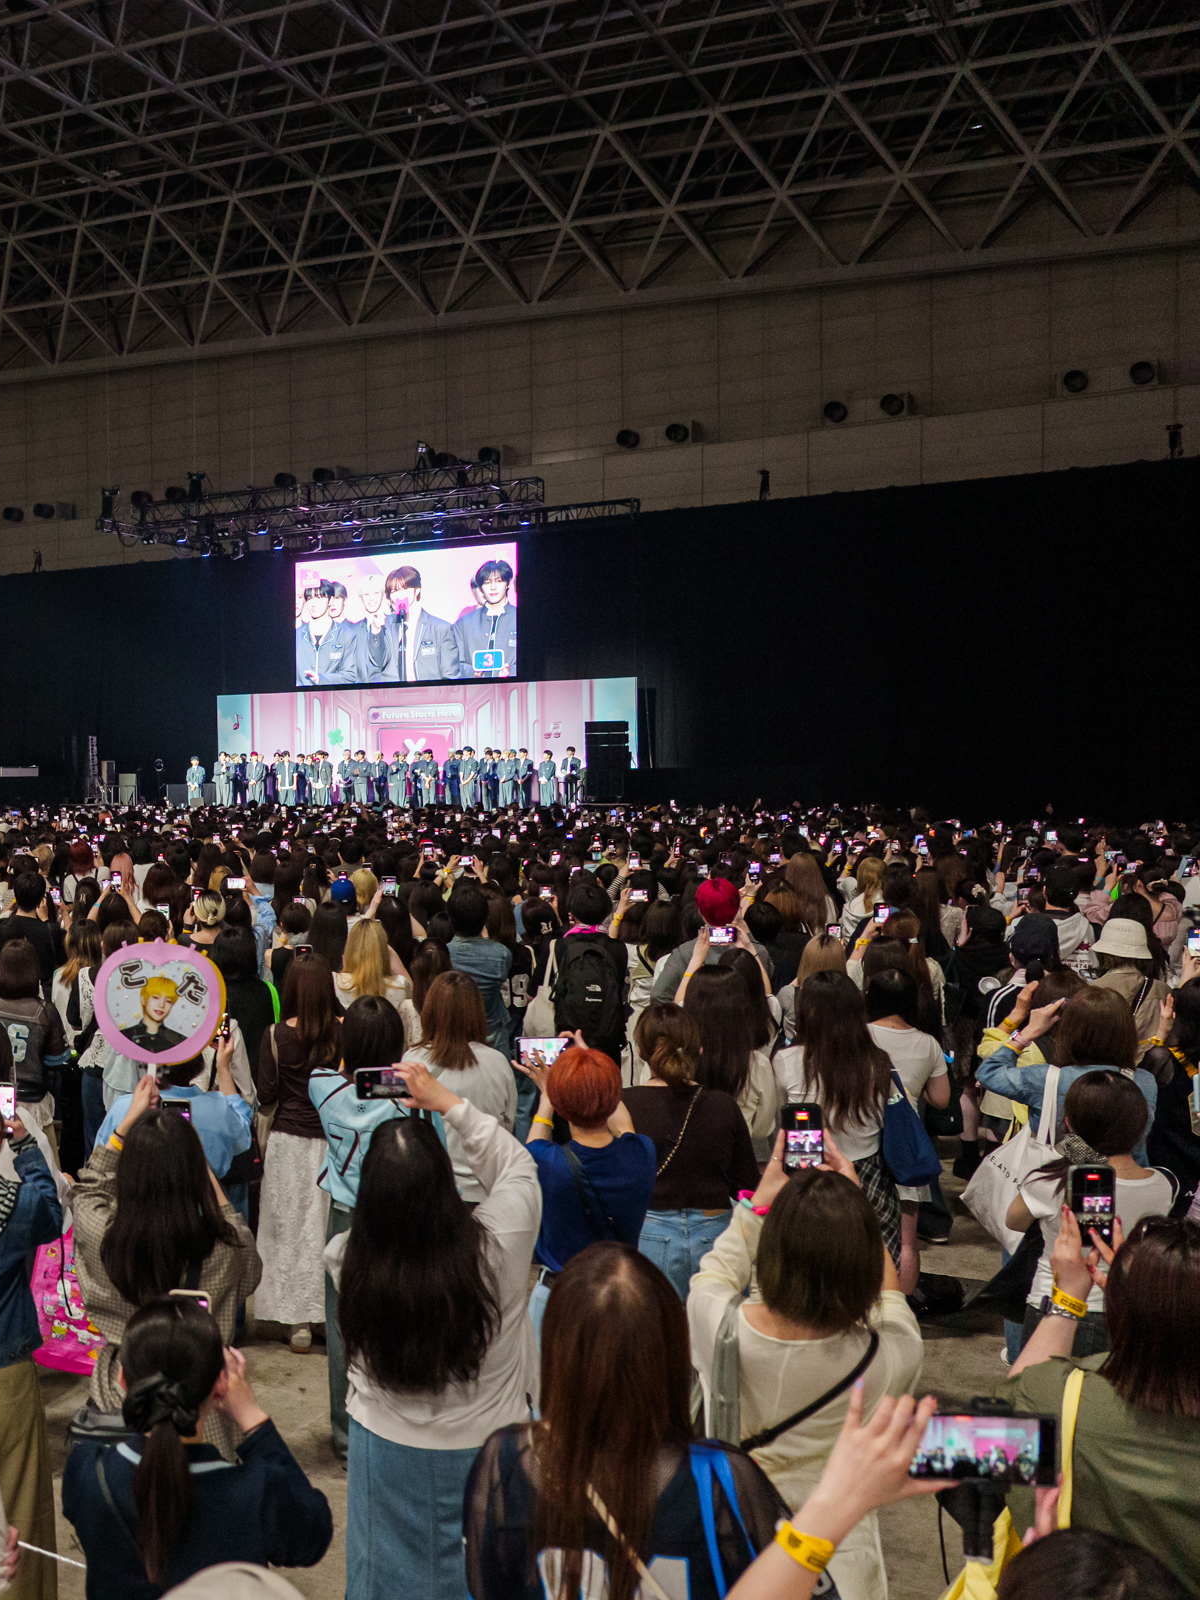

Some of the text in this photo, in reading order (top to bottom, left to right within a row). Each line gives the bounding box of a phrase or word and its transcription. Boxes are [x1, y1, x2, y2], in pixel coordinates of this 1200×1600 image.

[483, 653, 494, 667] 3
[382, 709, 458, 720] Future Starts Here
[987, 1155, 1011, 1179] ELATO
